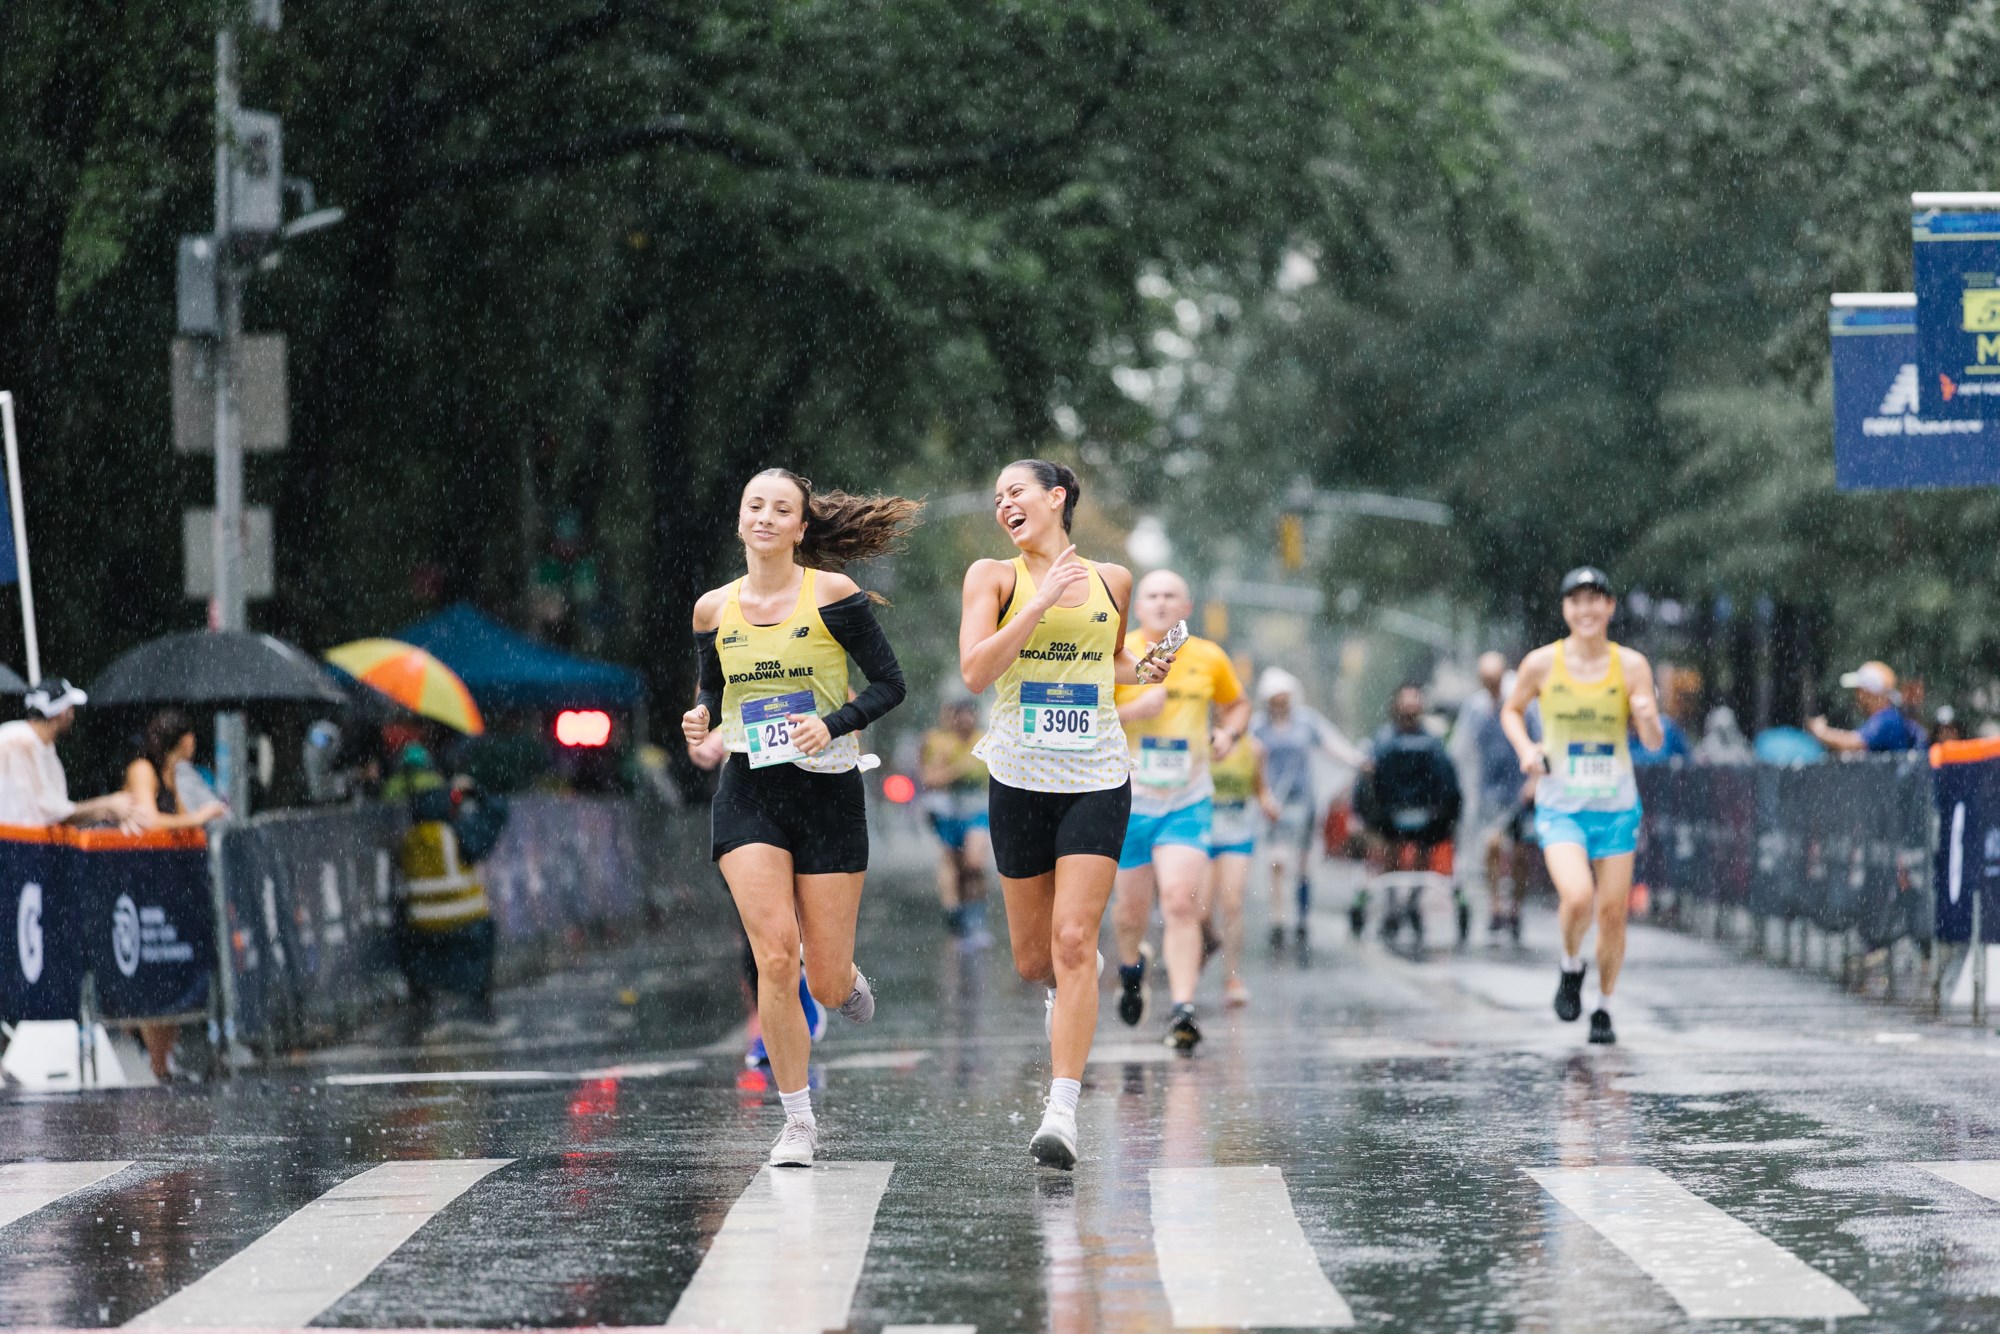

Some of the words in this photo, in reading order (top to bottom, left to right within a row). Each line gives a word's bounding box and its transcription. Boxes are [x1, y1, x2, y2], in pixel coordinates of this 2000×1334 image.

[1049, 642, 1077, 652] 2026
[1019, 649, 1079, 661] BROADWAY
[1081, 651, 1103, 661] MILE
[755, 660, 781, 671] 2026
[728, 669, 785, 684] BROADWAY
[788, 667, 813, 678] MILE
[1043, 709, 1089, 733] 3906
